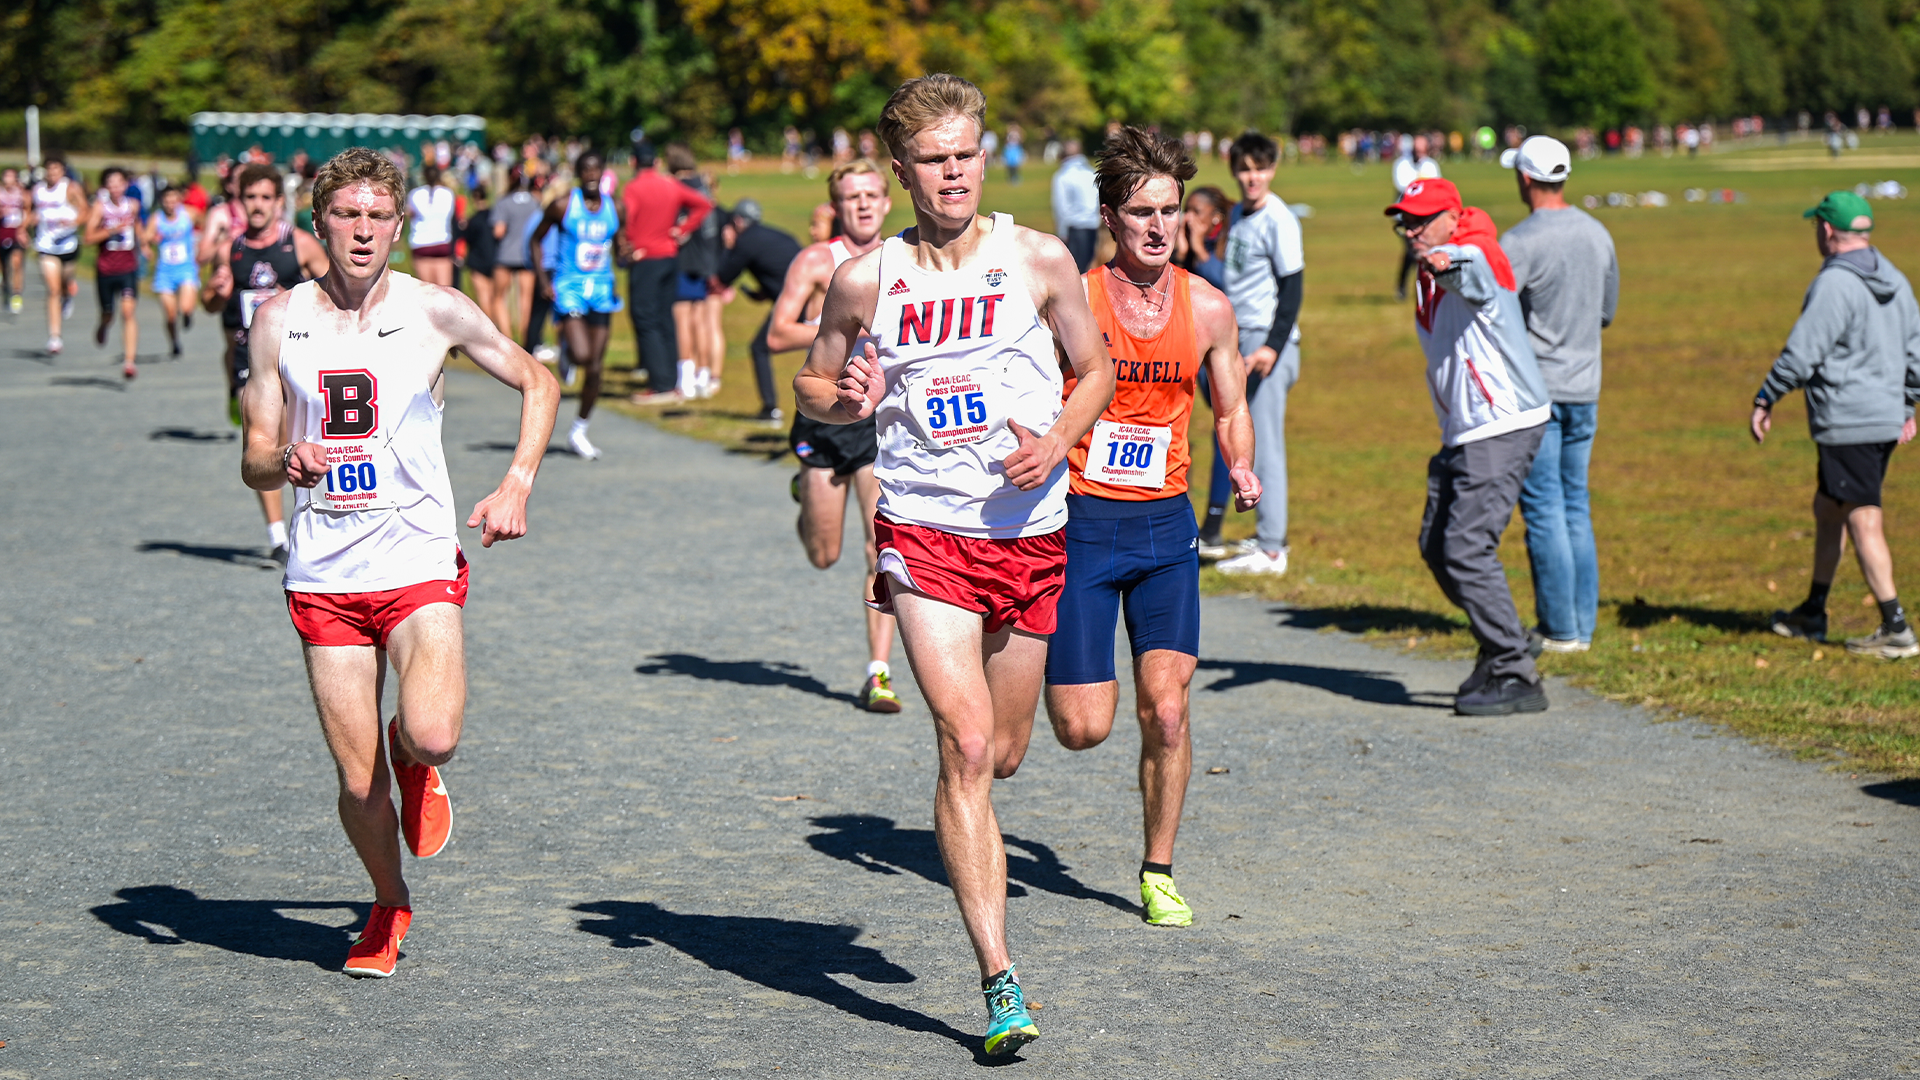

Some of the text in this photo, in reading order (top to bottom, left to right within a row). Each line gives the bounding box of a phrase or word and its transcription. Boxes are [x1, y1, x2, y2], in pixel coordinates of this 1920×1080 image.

[896, 293, 1005, 348] NJIT
[288, 330, 302, 341] Ivy
[932, 374, 971, 386] IC4A/ECAC
[925, 383, 981, 397] Cross Country
[318, 368, 379, 440] B
[926, 392, 987, 429] 315
[932, 424, 989, 439] Championships
[1118, 426, 1151, 435] IC4A/ECAC
[953, 435, 981, 445] ATHLETIC
[1109, 432, 1156, 444] Cross Country
[343, 454, 373, 463] Country
[1107, 441, 1154, 469] 180
[326, 462, 377, 493] 160
[324, 491, 378, 502] Championships
